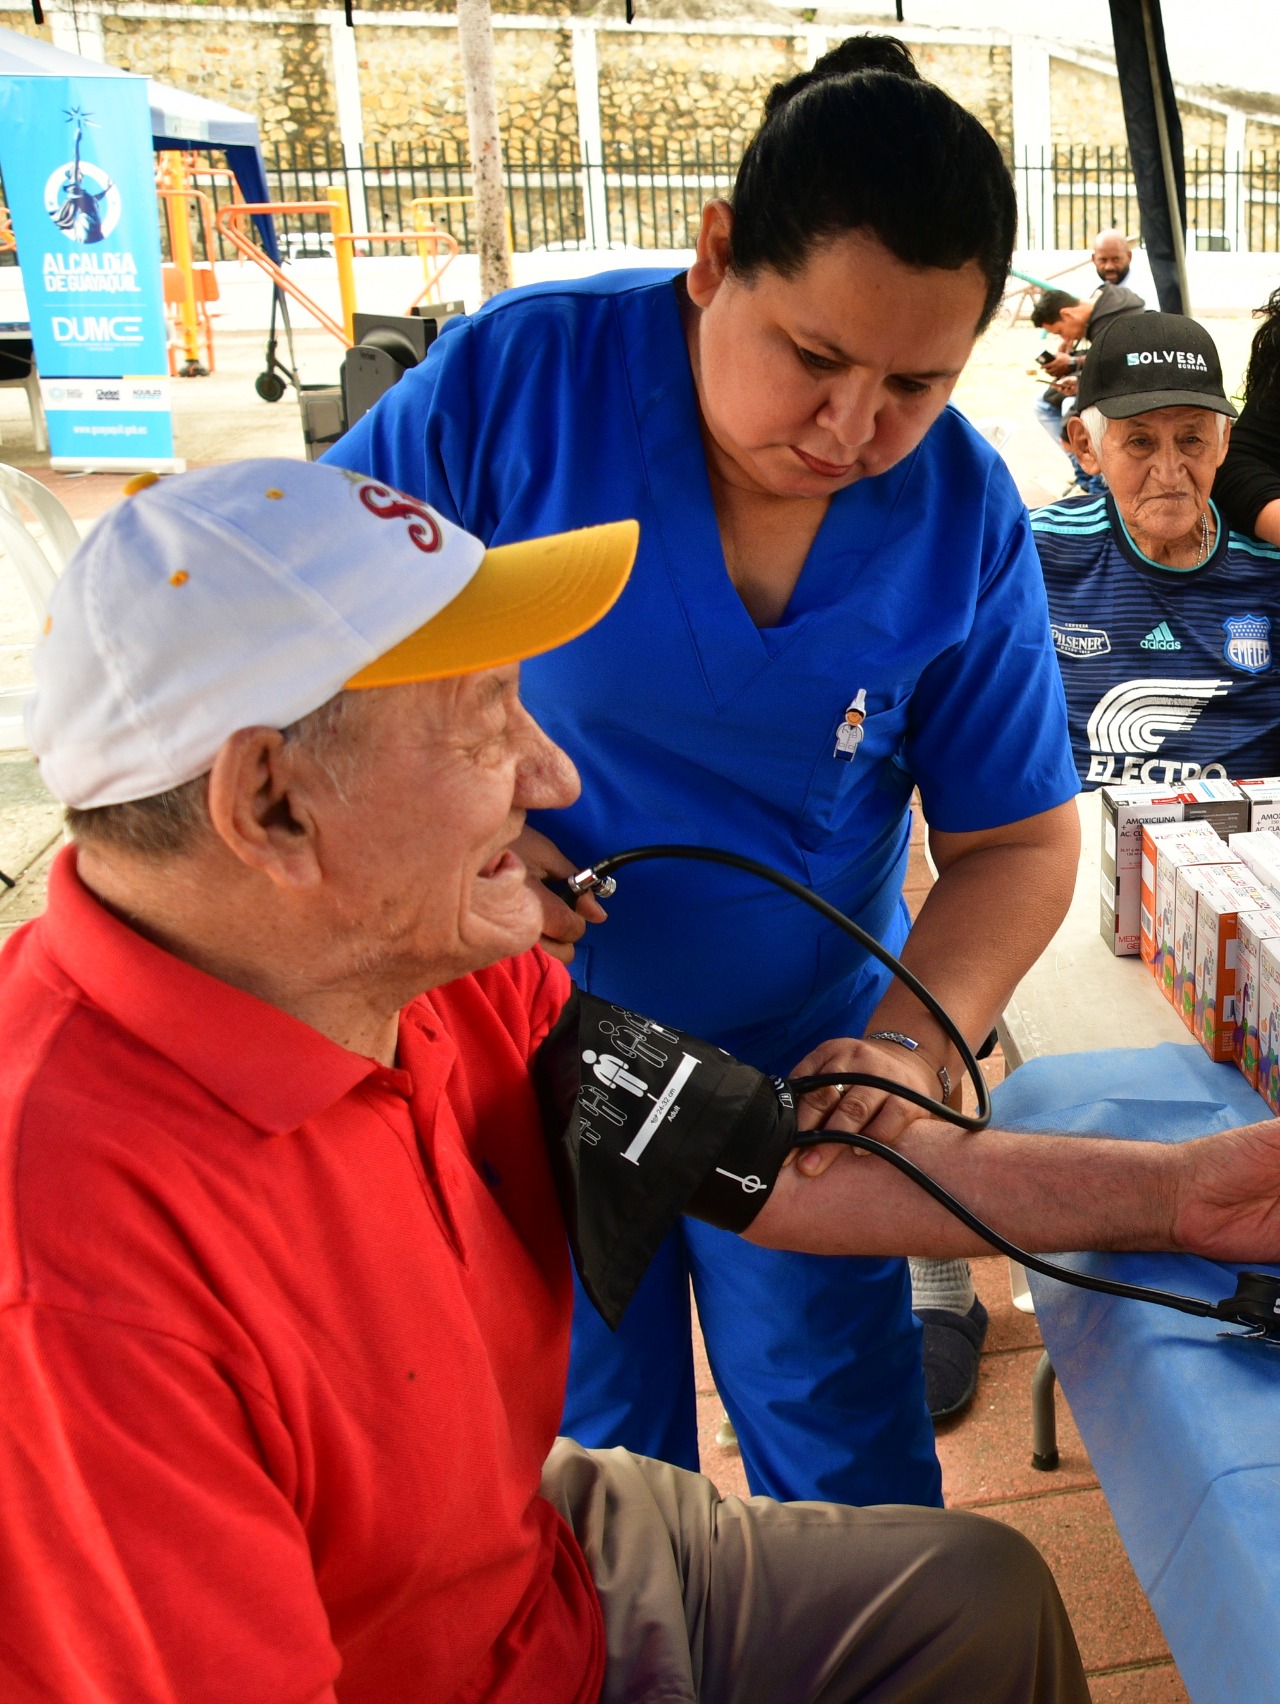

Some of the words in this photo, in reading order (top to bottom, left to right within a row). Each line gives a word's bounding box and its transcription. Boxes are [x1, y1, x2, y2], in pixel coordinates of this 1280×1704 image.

[44, 275, 68, 292] DE
[68, 275, 142, 294] GUAYAQUIL
[1126, 351, 1207, 366] SOLVESA
[1140, 638, 1181, 651] adidas
[1229, 640, 1270, 667] EMELEC
[1126, 816, 1176, 825] AMOXICILINA
